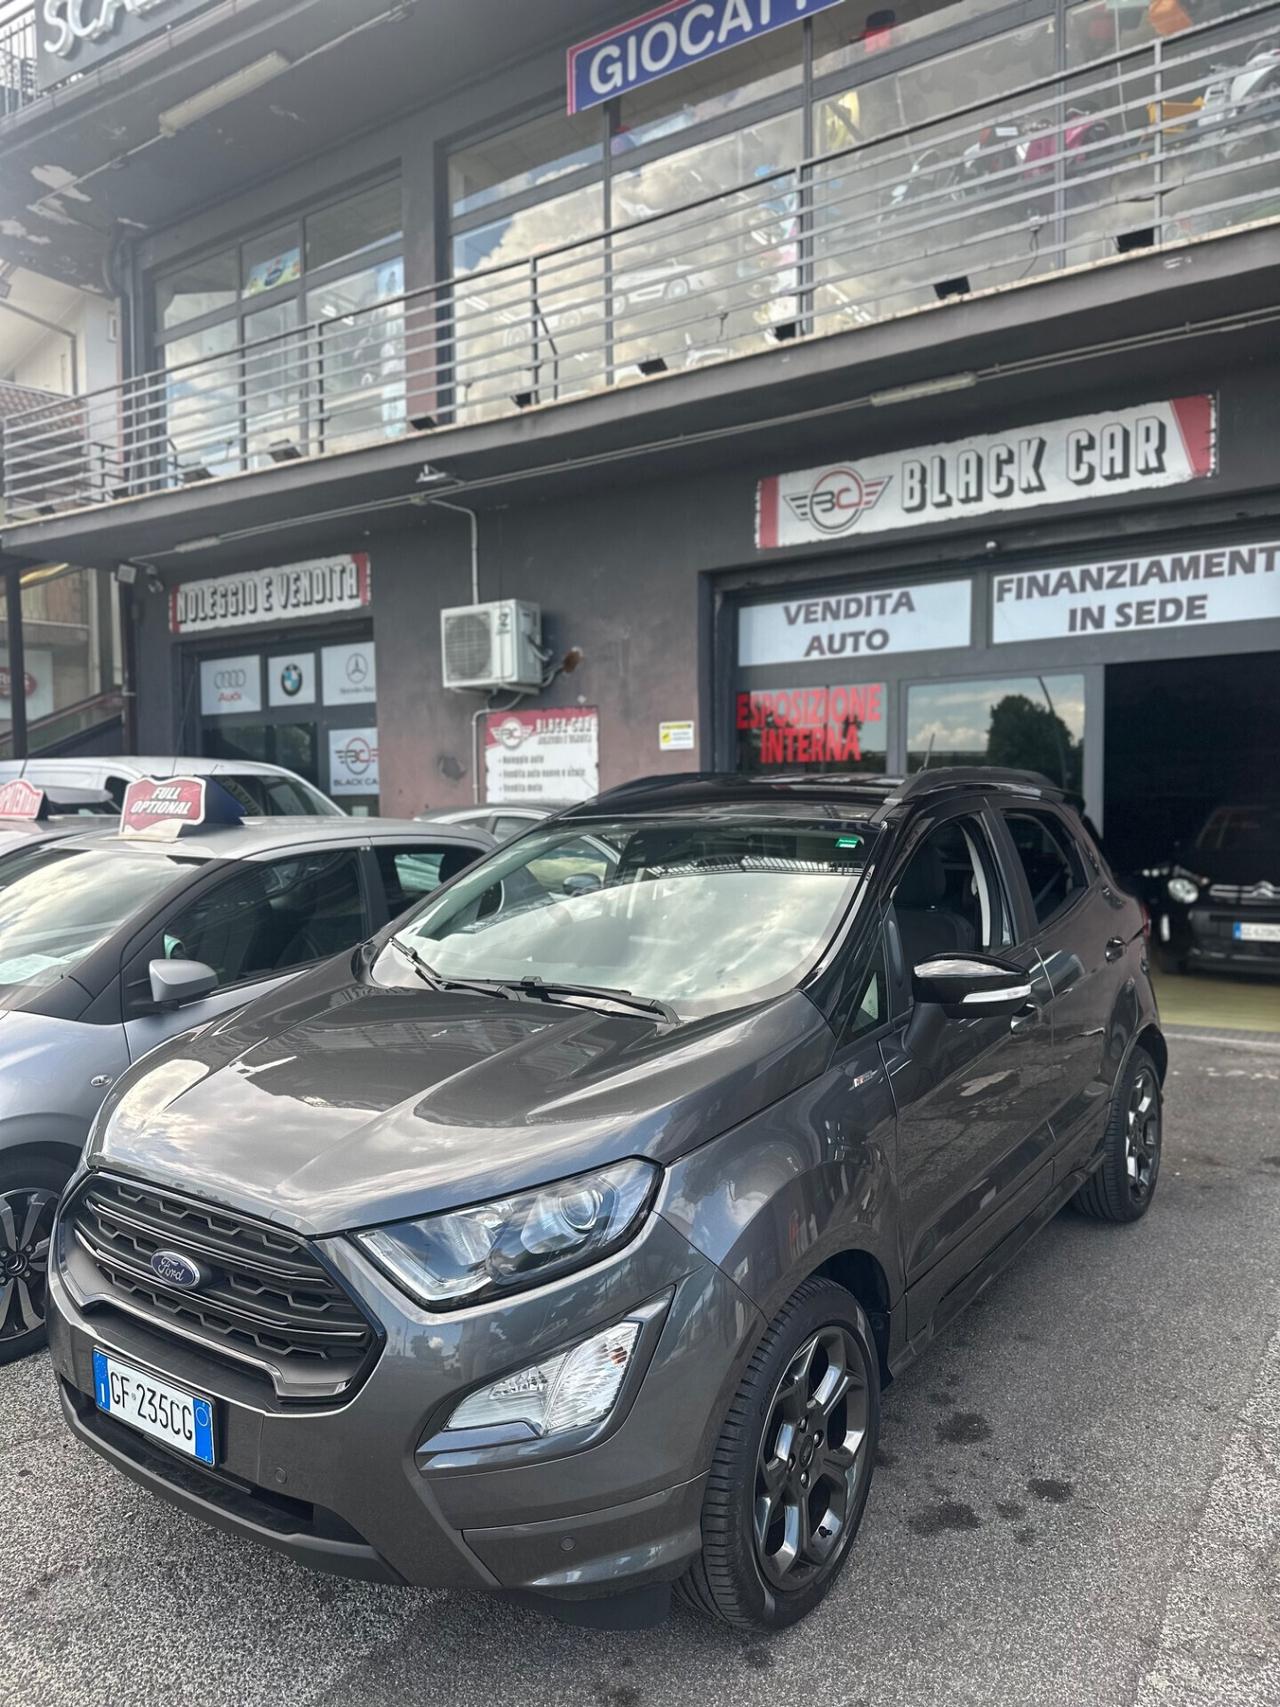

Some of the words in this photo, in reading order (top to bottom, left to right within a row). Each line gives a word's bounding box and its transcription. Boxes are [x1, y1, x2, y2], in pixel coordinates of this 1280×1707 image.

[590, 0, 807, 94] GIOCA
[902, 437, 1046, 512] BLACK
[1066, 416, 1166, 485] CAR
[177, 578, 258, 625] NOLEGGIO
[263, 577, 273, 612] E
[278, 562, 360, 610] VENDITA
[996, 547, 1280, 603] FINANZIAMENT
[783, 590, 915, 626] VENDITA
[1068, 605, 1106, 632] IN
[1115, 594, 1208, 628] SEDE
[803, 629, 889, 657] AUTO
[218, 691, 242, 702] Audi
[736, 683, 882, 730] ESPOSIZIONE
[760, 726, 862, 764] INTERNA
[152, 786, 181, 799] FULL
[333, 779, 362, 787] BLACK
[131, 800, 192, 815] OPTIONAL
[158, 1256, 185, 1281] Ford
